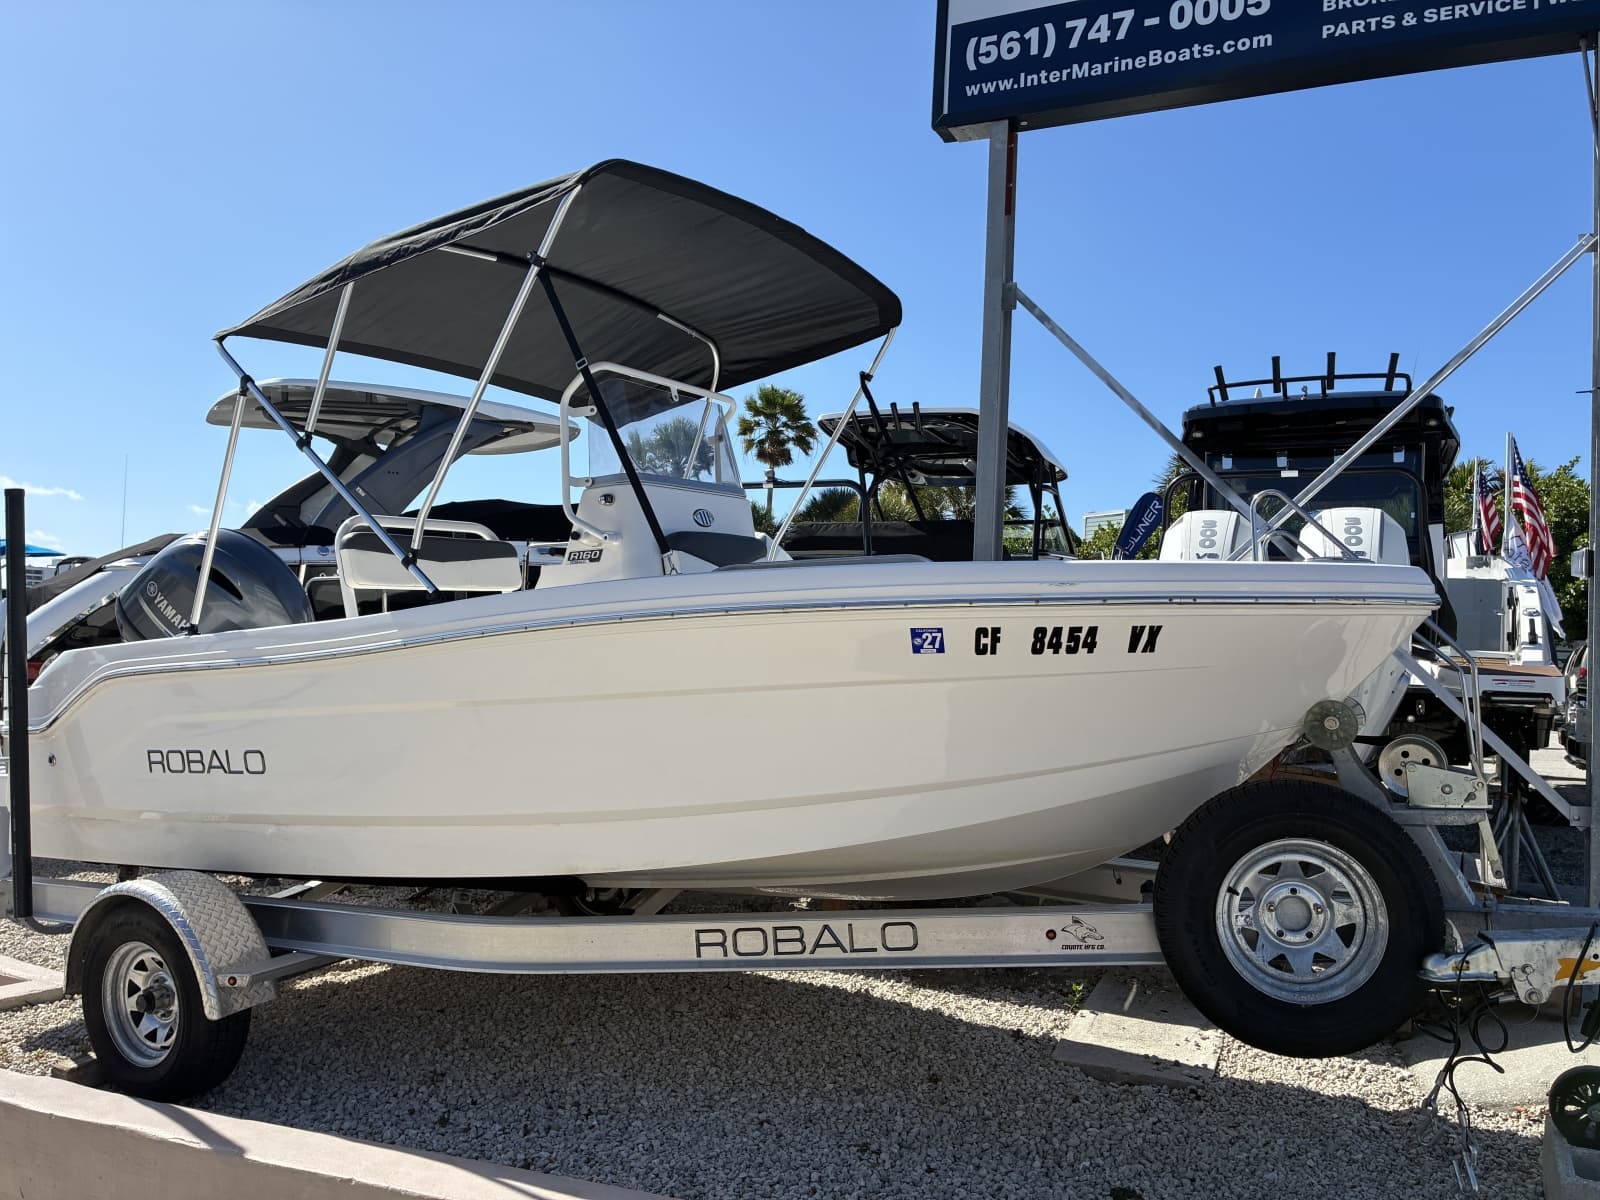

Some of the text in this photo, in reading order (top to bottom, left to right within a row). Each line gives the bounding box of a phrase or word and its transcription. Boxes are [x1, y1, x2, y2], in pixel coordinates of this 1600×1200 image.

[1321, 15, 1396, 39] PARTS
[1401, 12, 1418, 26] &
[1423, 0, 1527, 23] SERVICE
[965, 22, 1056, 71] (561)
[1065, 8, 1135, 49] 747
[965, 33, 1273, 97] www.InterMarineBoats.com
[1123, 500, 1163, 556] YLINER
[570, 550, 600, 561] R160
[154, 591, 192, 629] YAMAH
[921, 632, 942, 649] 27
[974, 625, 1163, 656] CF 8454 VX
[146, 749, 267, 775] ROBALO
[694, 921, 919, 958] ROBALO
